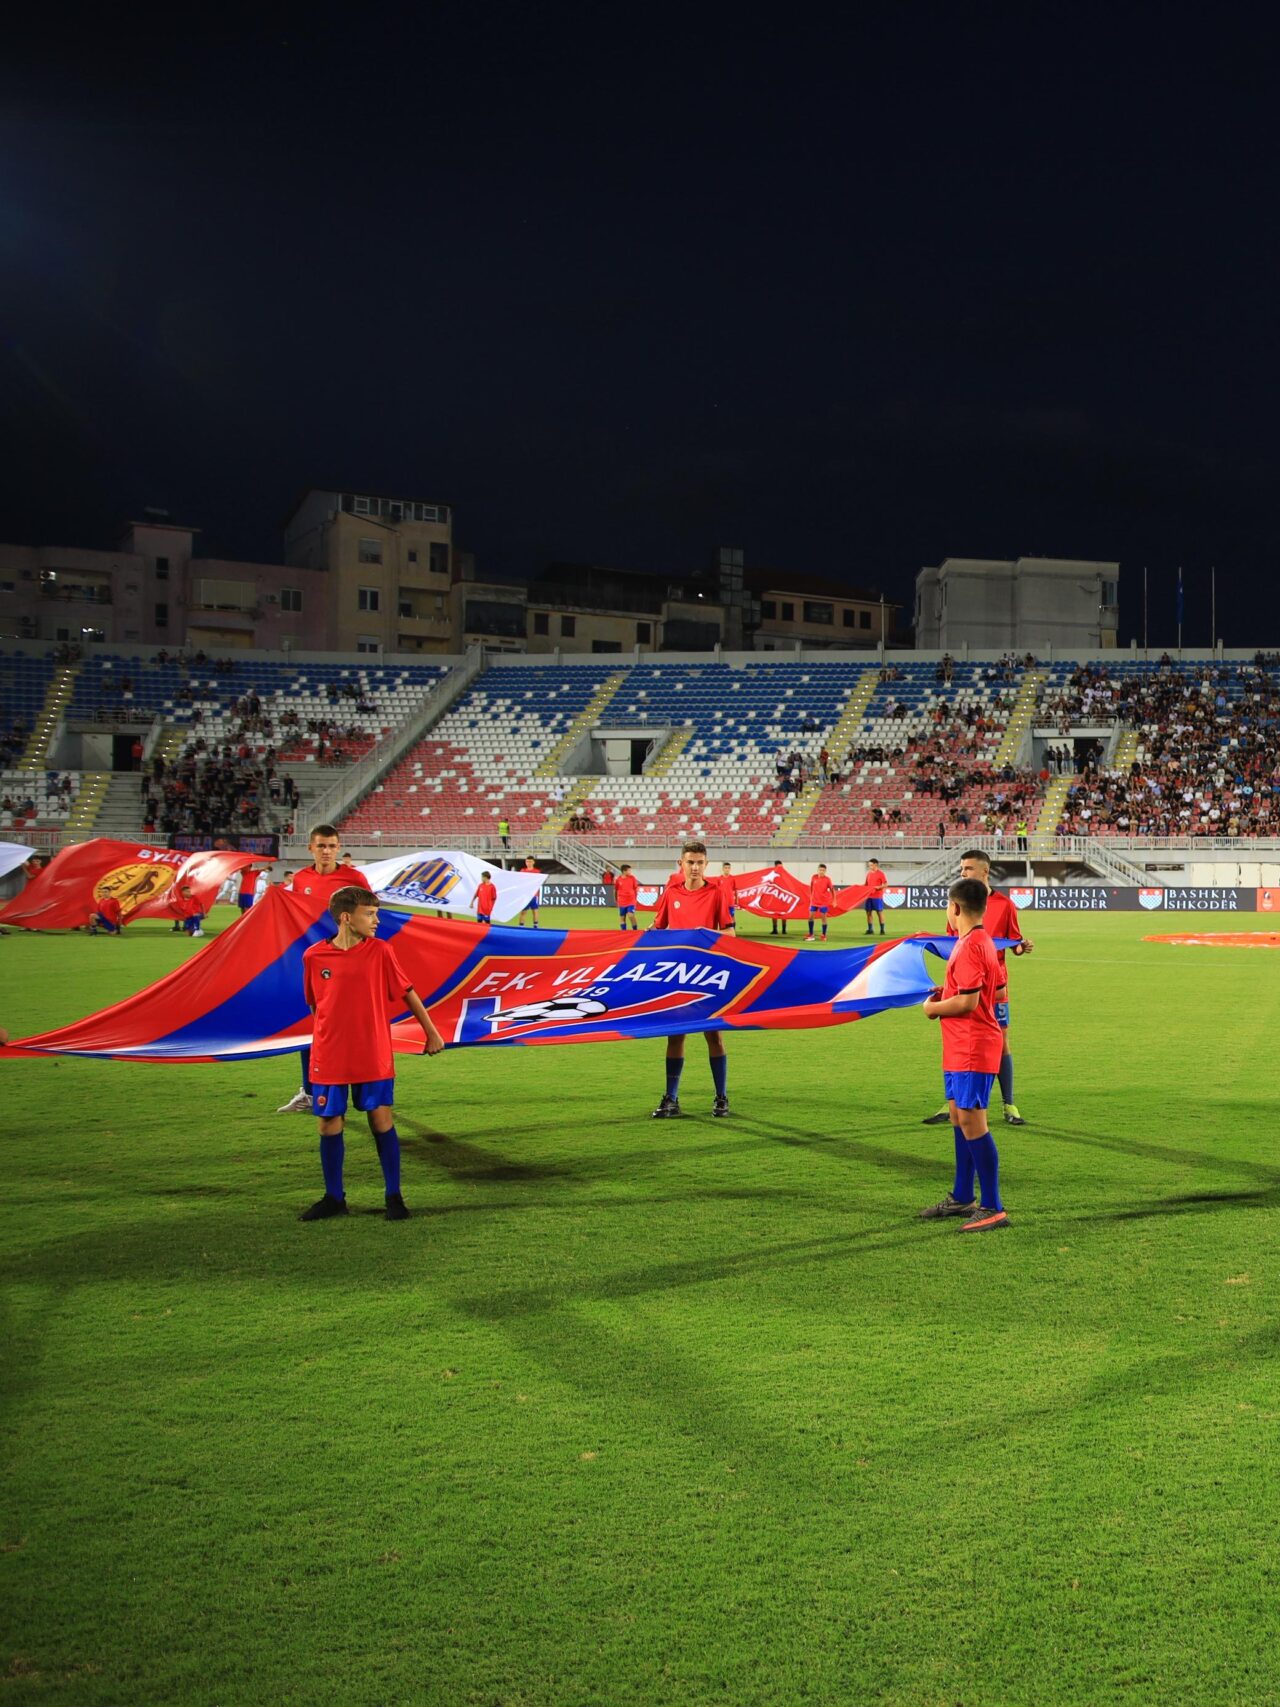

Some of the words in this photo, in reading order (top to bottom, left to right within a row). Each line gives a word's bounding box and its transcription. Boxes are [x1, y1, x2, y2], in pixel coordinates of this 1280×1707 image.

[544, 886, 607, 895] BASHKIA
[912, 888, 949, 897] BASH
[1040, 888, 1107, 898] BASHKIA
[1169, 889, 1238, 899] BASHKIA
[911, 899, 948, 909] SHKO
[471, 971, 542, 993] F.K.
[551, 961, 730, 990] VLLAZNIA
[553, 986, 609, 999] 1919
